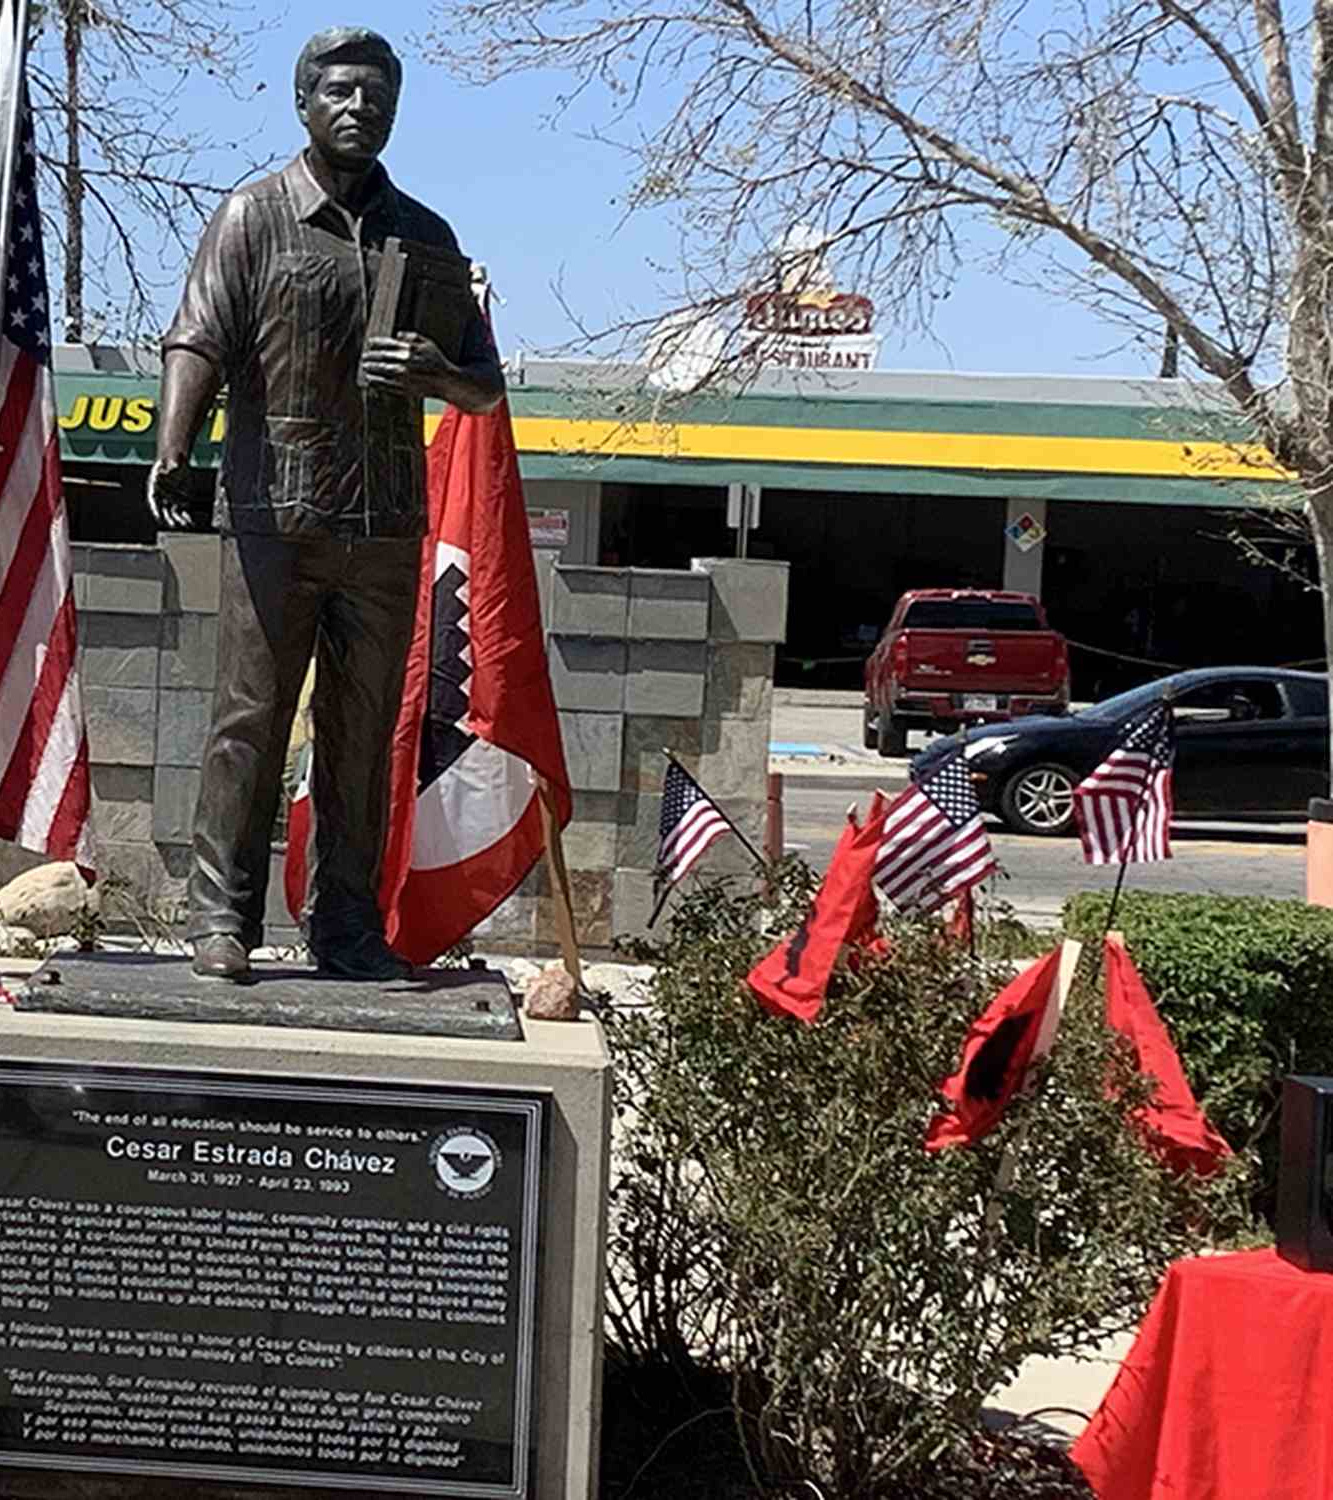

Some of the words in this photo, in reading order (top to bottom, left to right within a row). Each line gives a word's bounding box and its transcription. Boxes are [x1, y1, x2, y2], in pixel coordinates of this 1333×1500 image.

[58, 395, 155, 432] JUS
[72, 1110, 100, 1123] "The
[104, 1112, 128, 1125] end
[132, 1113, 147, 1126] of
[151, 1114, 167, 1127] all
[170, 1115, 234, 1130] education
[238, 1119, 281, 1133] should
[284, 1122, 301, 1134] be
[306, 1123, 353, 1137] service
[357, 1126, 372, 1138] to
[375, 1127, 427, 1141] others."
[106, 1135, 181, 1161] Cesar
[193, 1140, 292, 1167] Estrada
[303, 1146, 395, 1173] Chávez
[147, 1168, 187, 1182] March
[190, 1171, 207, 1184] 31,
[212, 1172, 242, 1185] 1927
[258, 1175, 289, 1190] April
[293, 1177, 314, 1190] 23,
[318, 1178, 349, 1191] 1993
